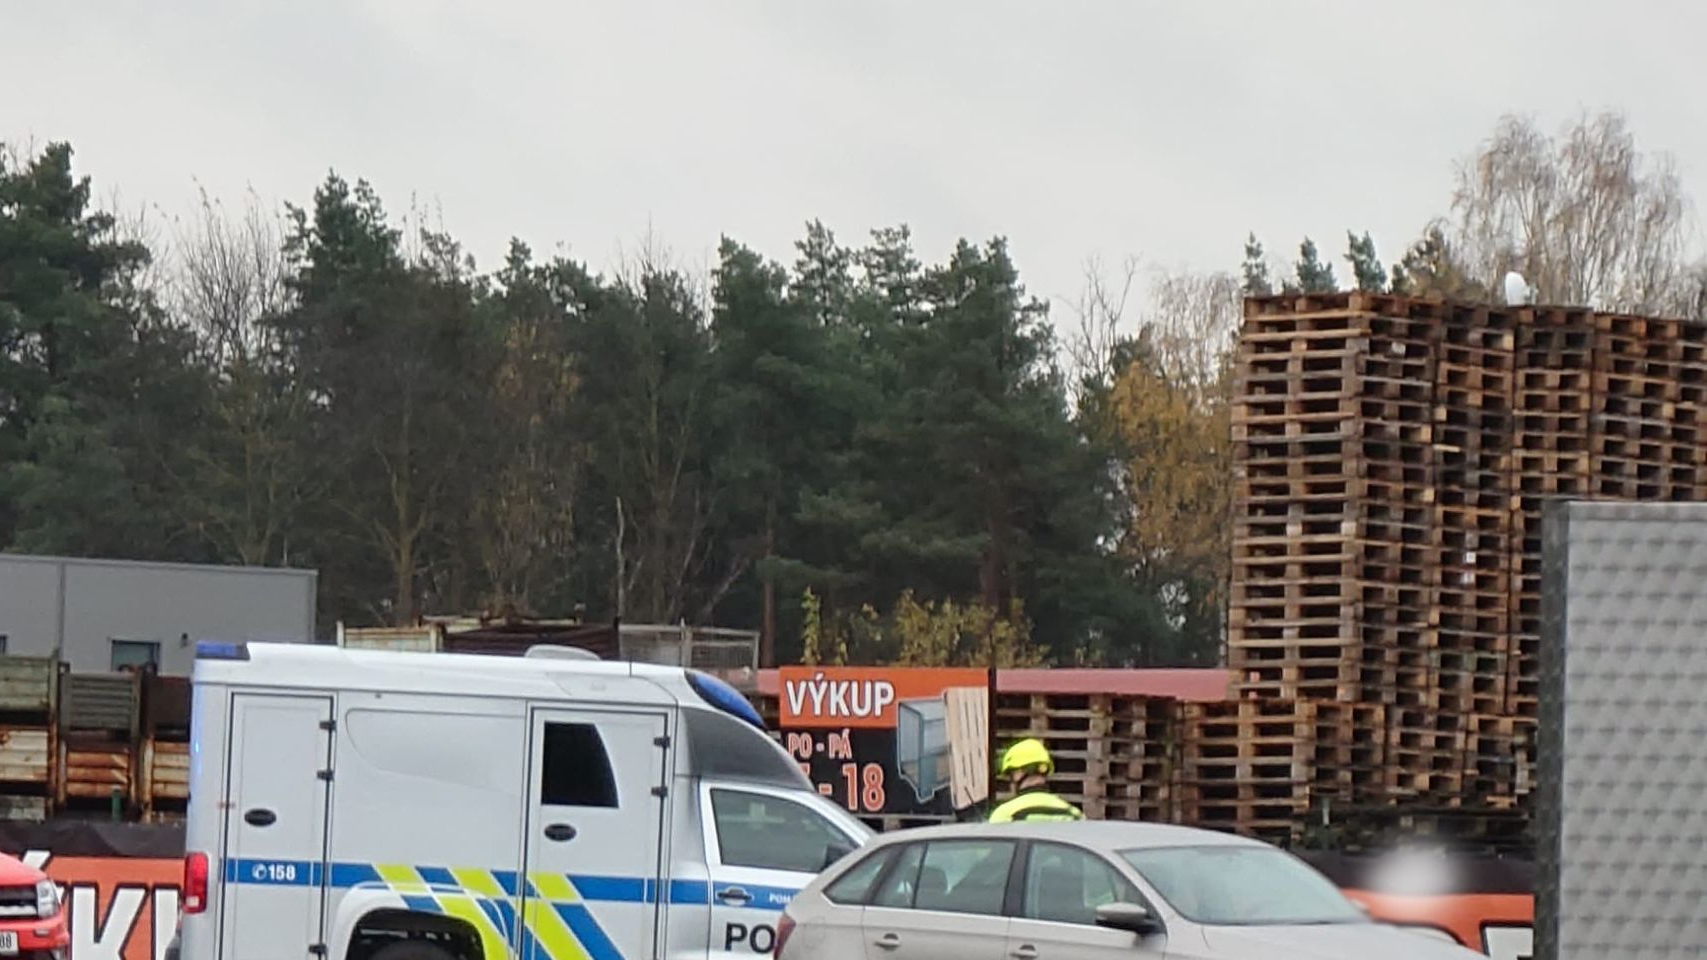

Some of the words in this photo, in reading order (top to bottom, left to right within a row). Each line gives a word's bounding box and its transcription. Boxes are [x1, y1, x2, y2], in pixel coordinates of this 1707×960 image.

[785, 672, 895, 717] VÝKUP
[788, 732, 813, 758] PO
[828, 728, 852, 759] PÁ
[842, 762, 885, 812] 18
[268, 864, 296, 880] 158
